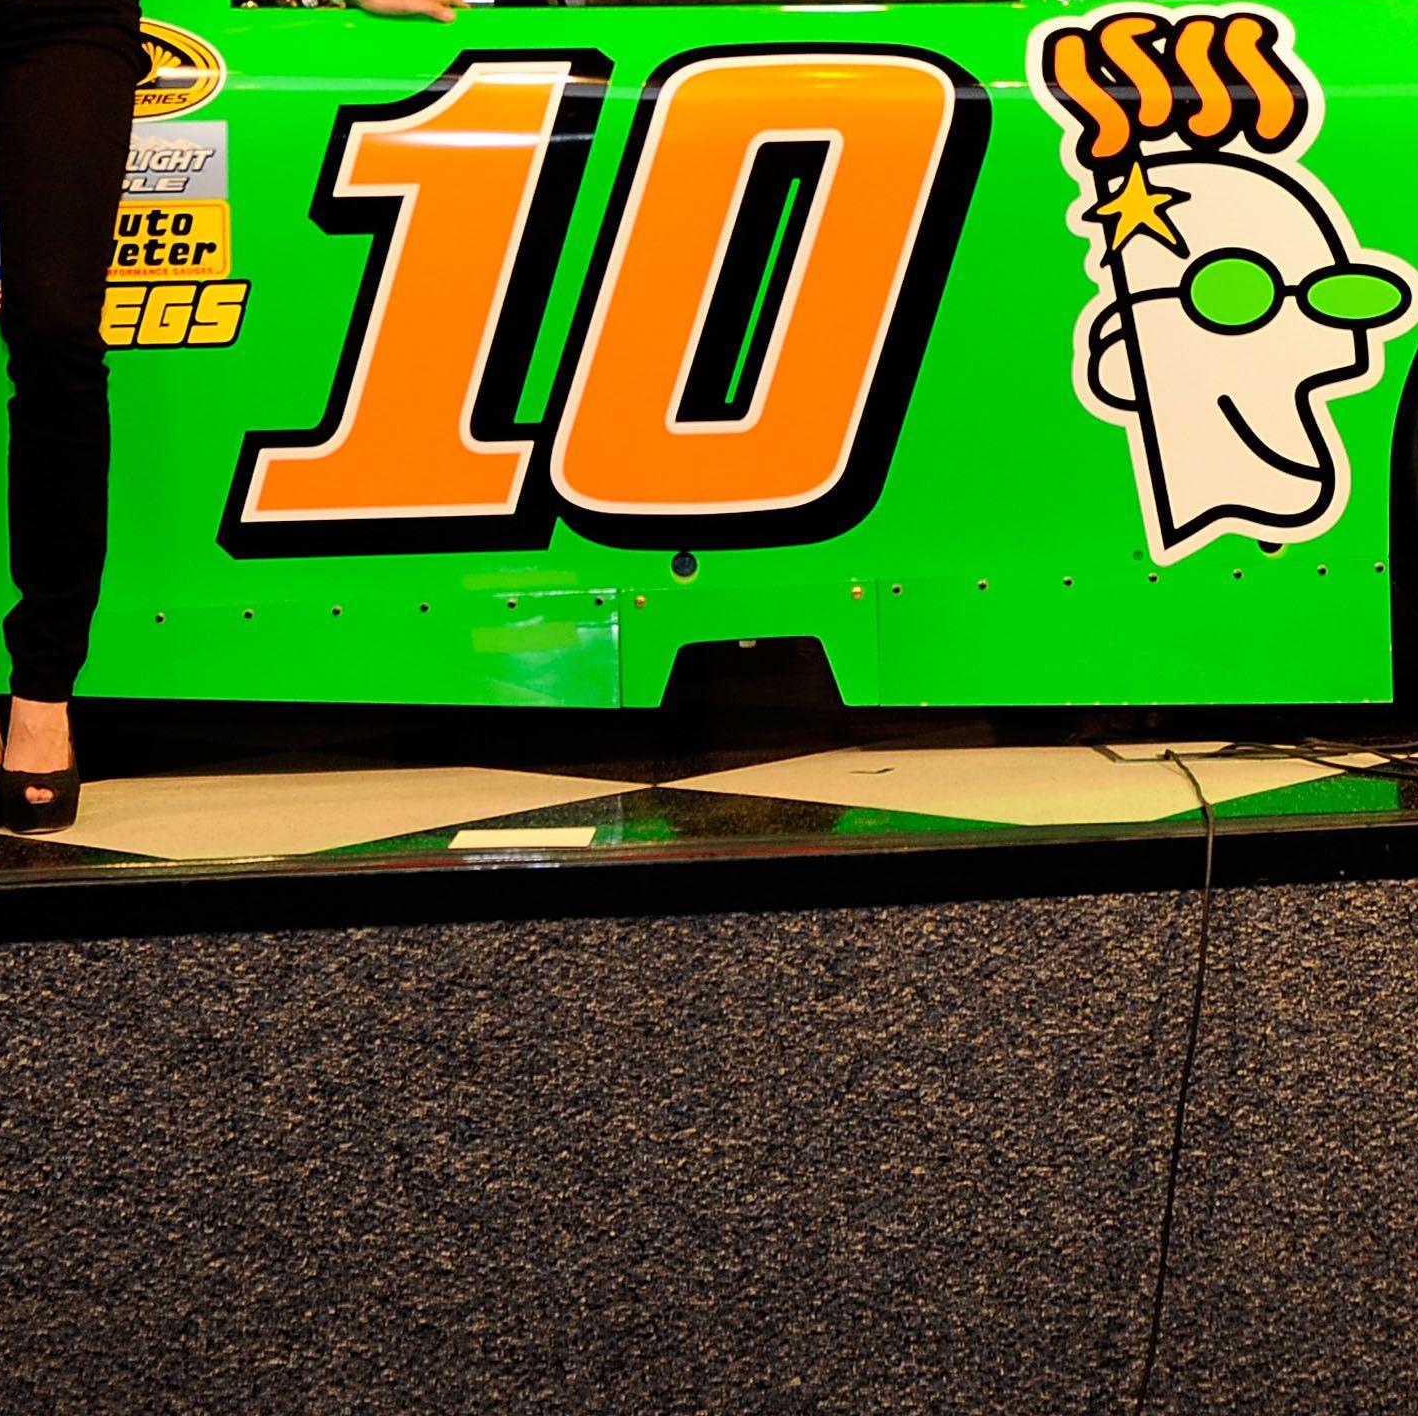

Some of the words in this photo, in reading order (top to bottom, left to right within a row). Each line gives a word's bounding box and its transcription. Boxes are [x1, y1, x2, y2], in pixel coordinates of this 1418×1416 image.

[134, 92, 189, 106] ERIES
[118, 209, 194, 237] uto
[99, 282, 249, 348] EGS
[226, 47, 976, 542] 10
